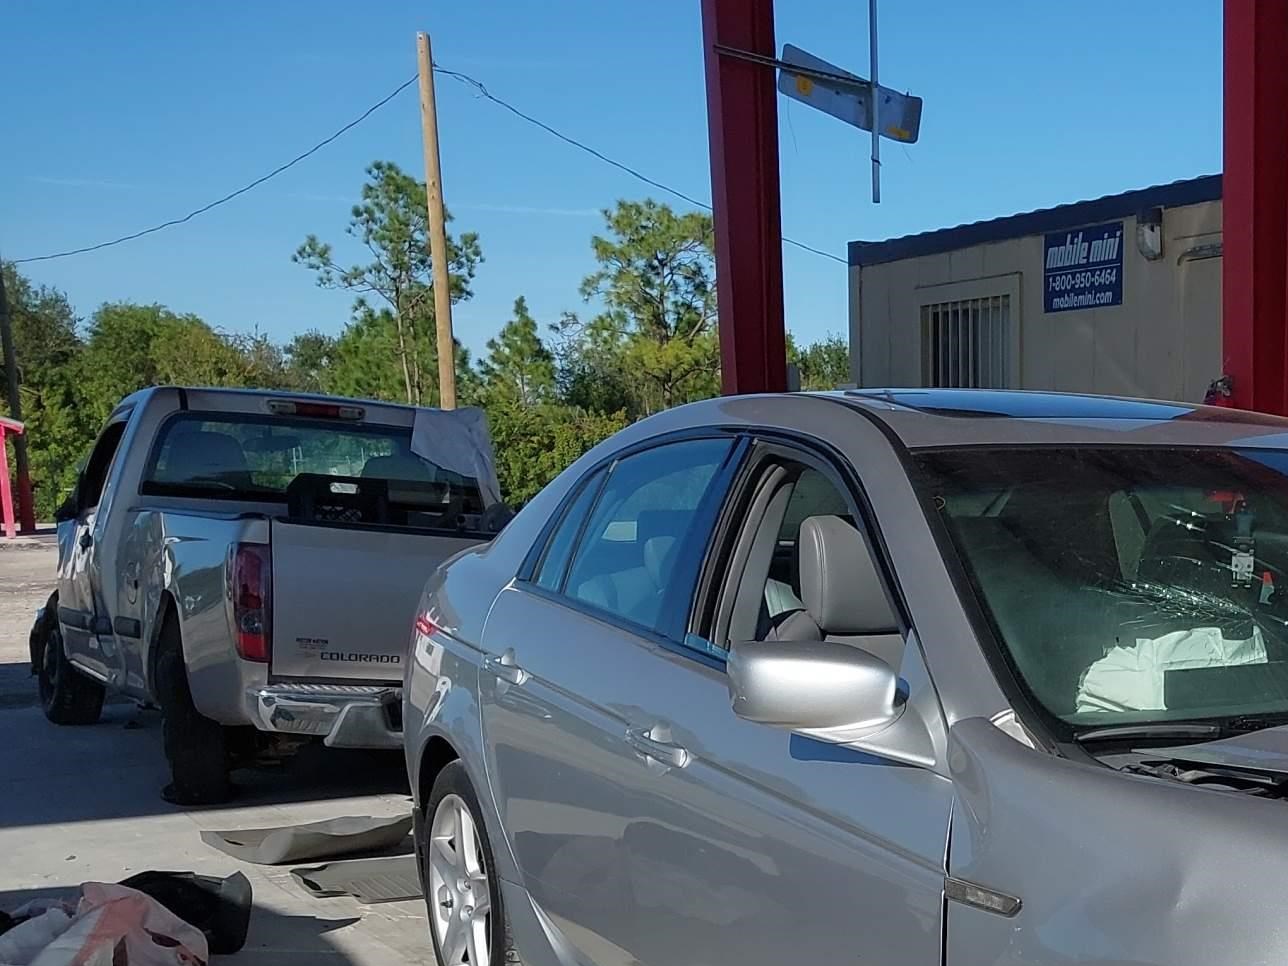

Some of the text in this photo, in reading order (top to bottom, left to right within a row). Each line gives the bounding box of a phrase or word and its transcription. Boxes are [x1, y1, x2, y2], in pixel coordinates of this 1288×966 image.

[1046, 230, 1121, 269] mobile mini
[1049, 268, 1117, 292] 1-800-950-6464
[1052, 289, 1113, 309] mobilemini.com
[320, 651, 401, 664] COLORADO
